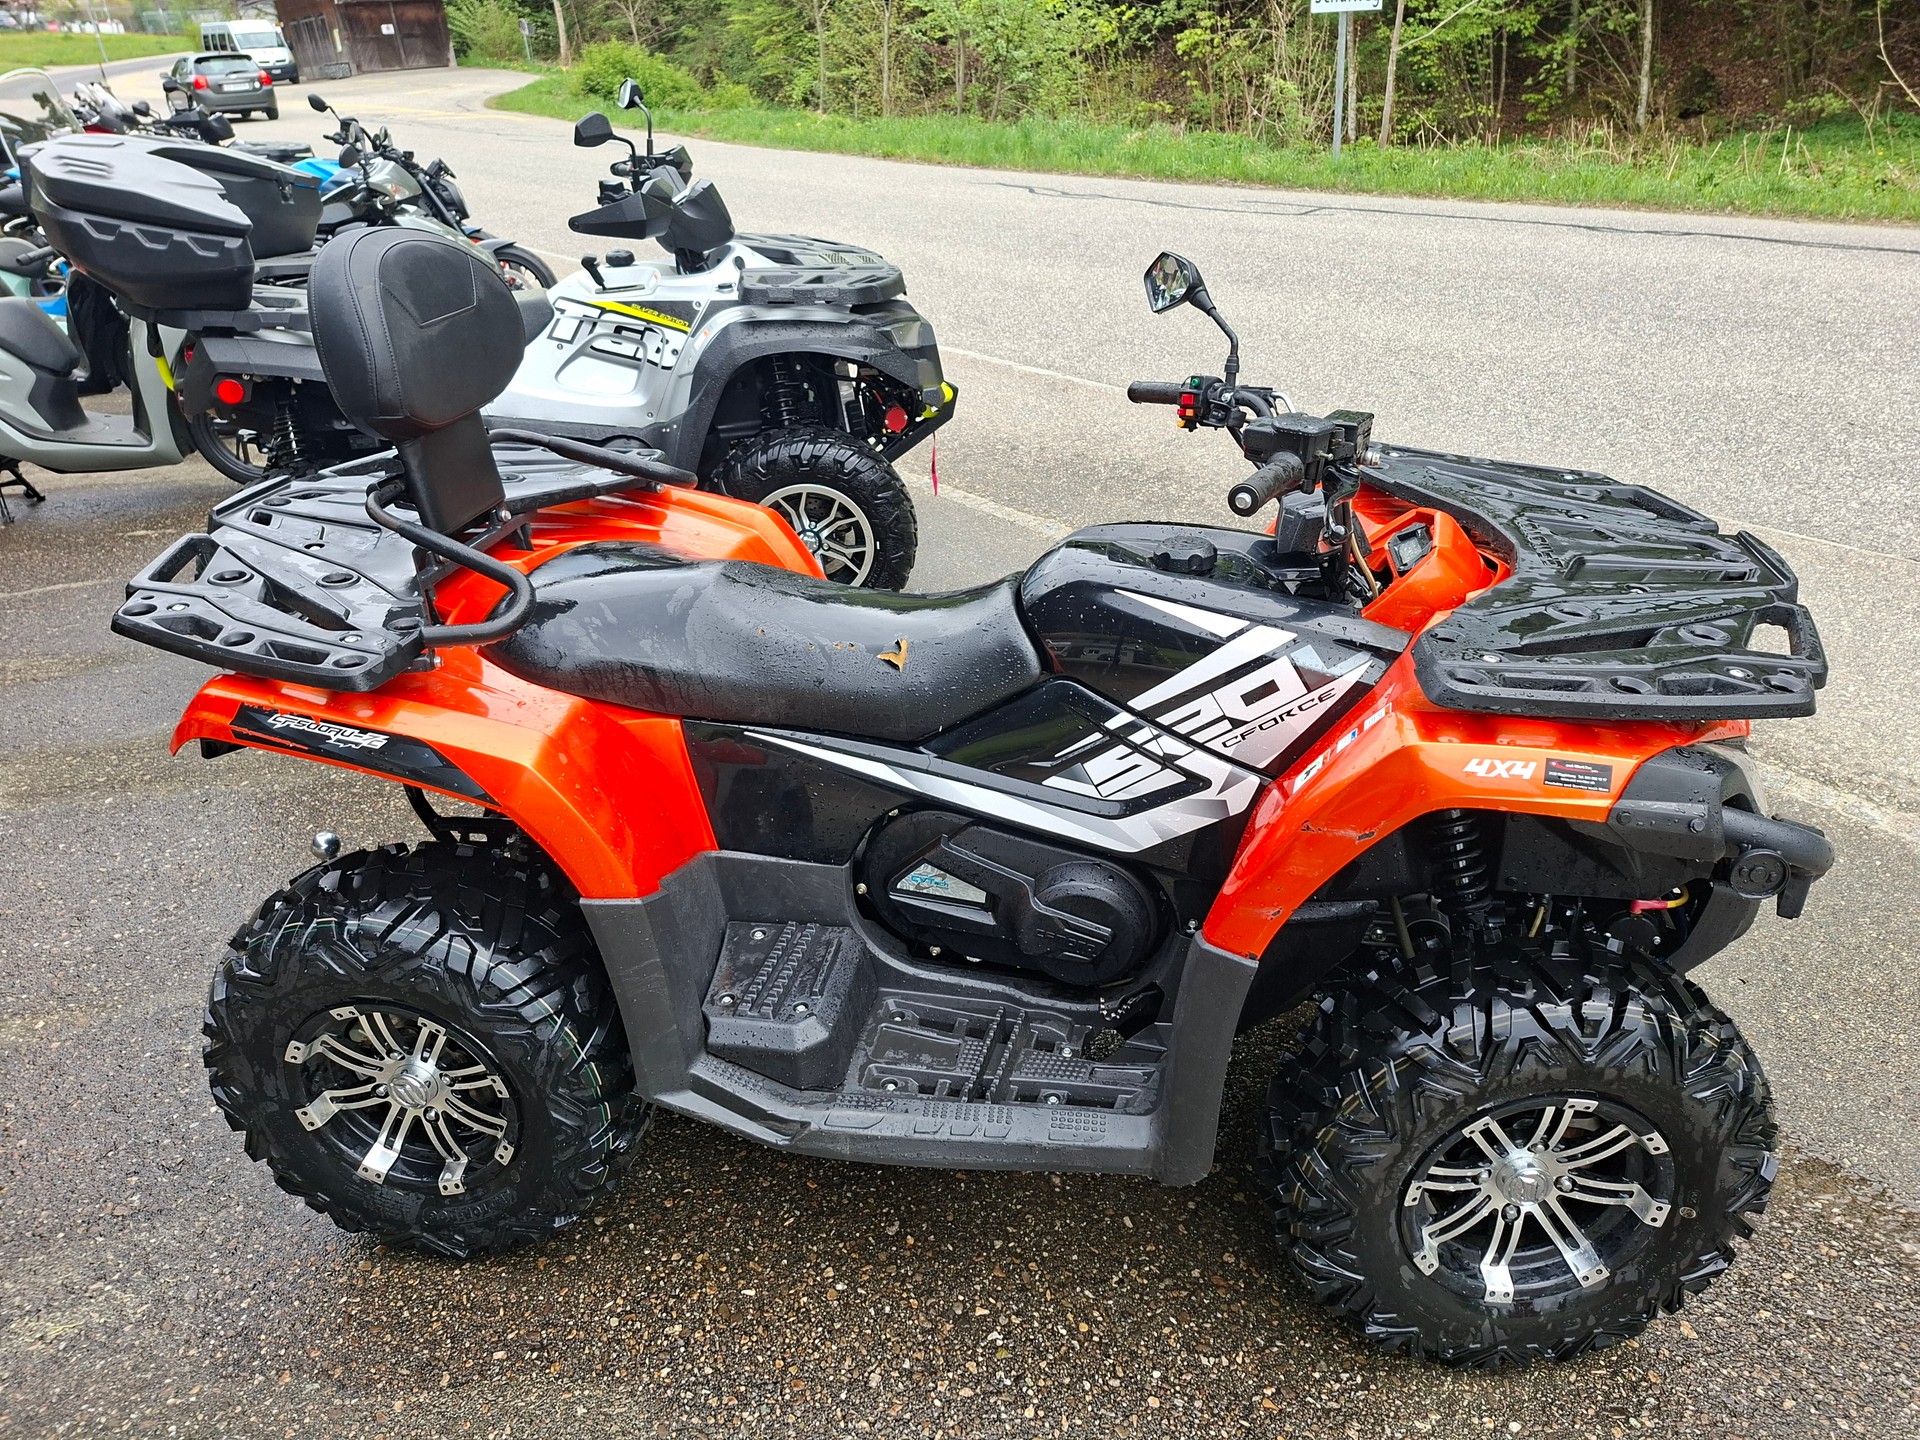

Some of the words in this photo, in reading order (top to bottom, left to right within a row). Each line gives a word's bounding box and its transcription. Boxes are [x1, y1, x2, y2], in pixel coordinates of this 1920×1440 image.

[630, 303, 659, 316] SILVER
[660, 313, 690, 327] EDITION
[1221, 687, 1338, 749] CFORCE
[1463, 758, 1538, 780] 4X4
[910, 874, 950, 888] CVTech
